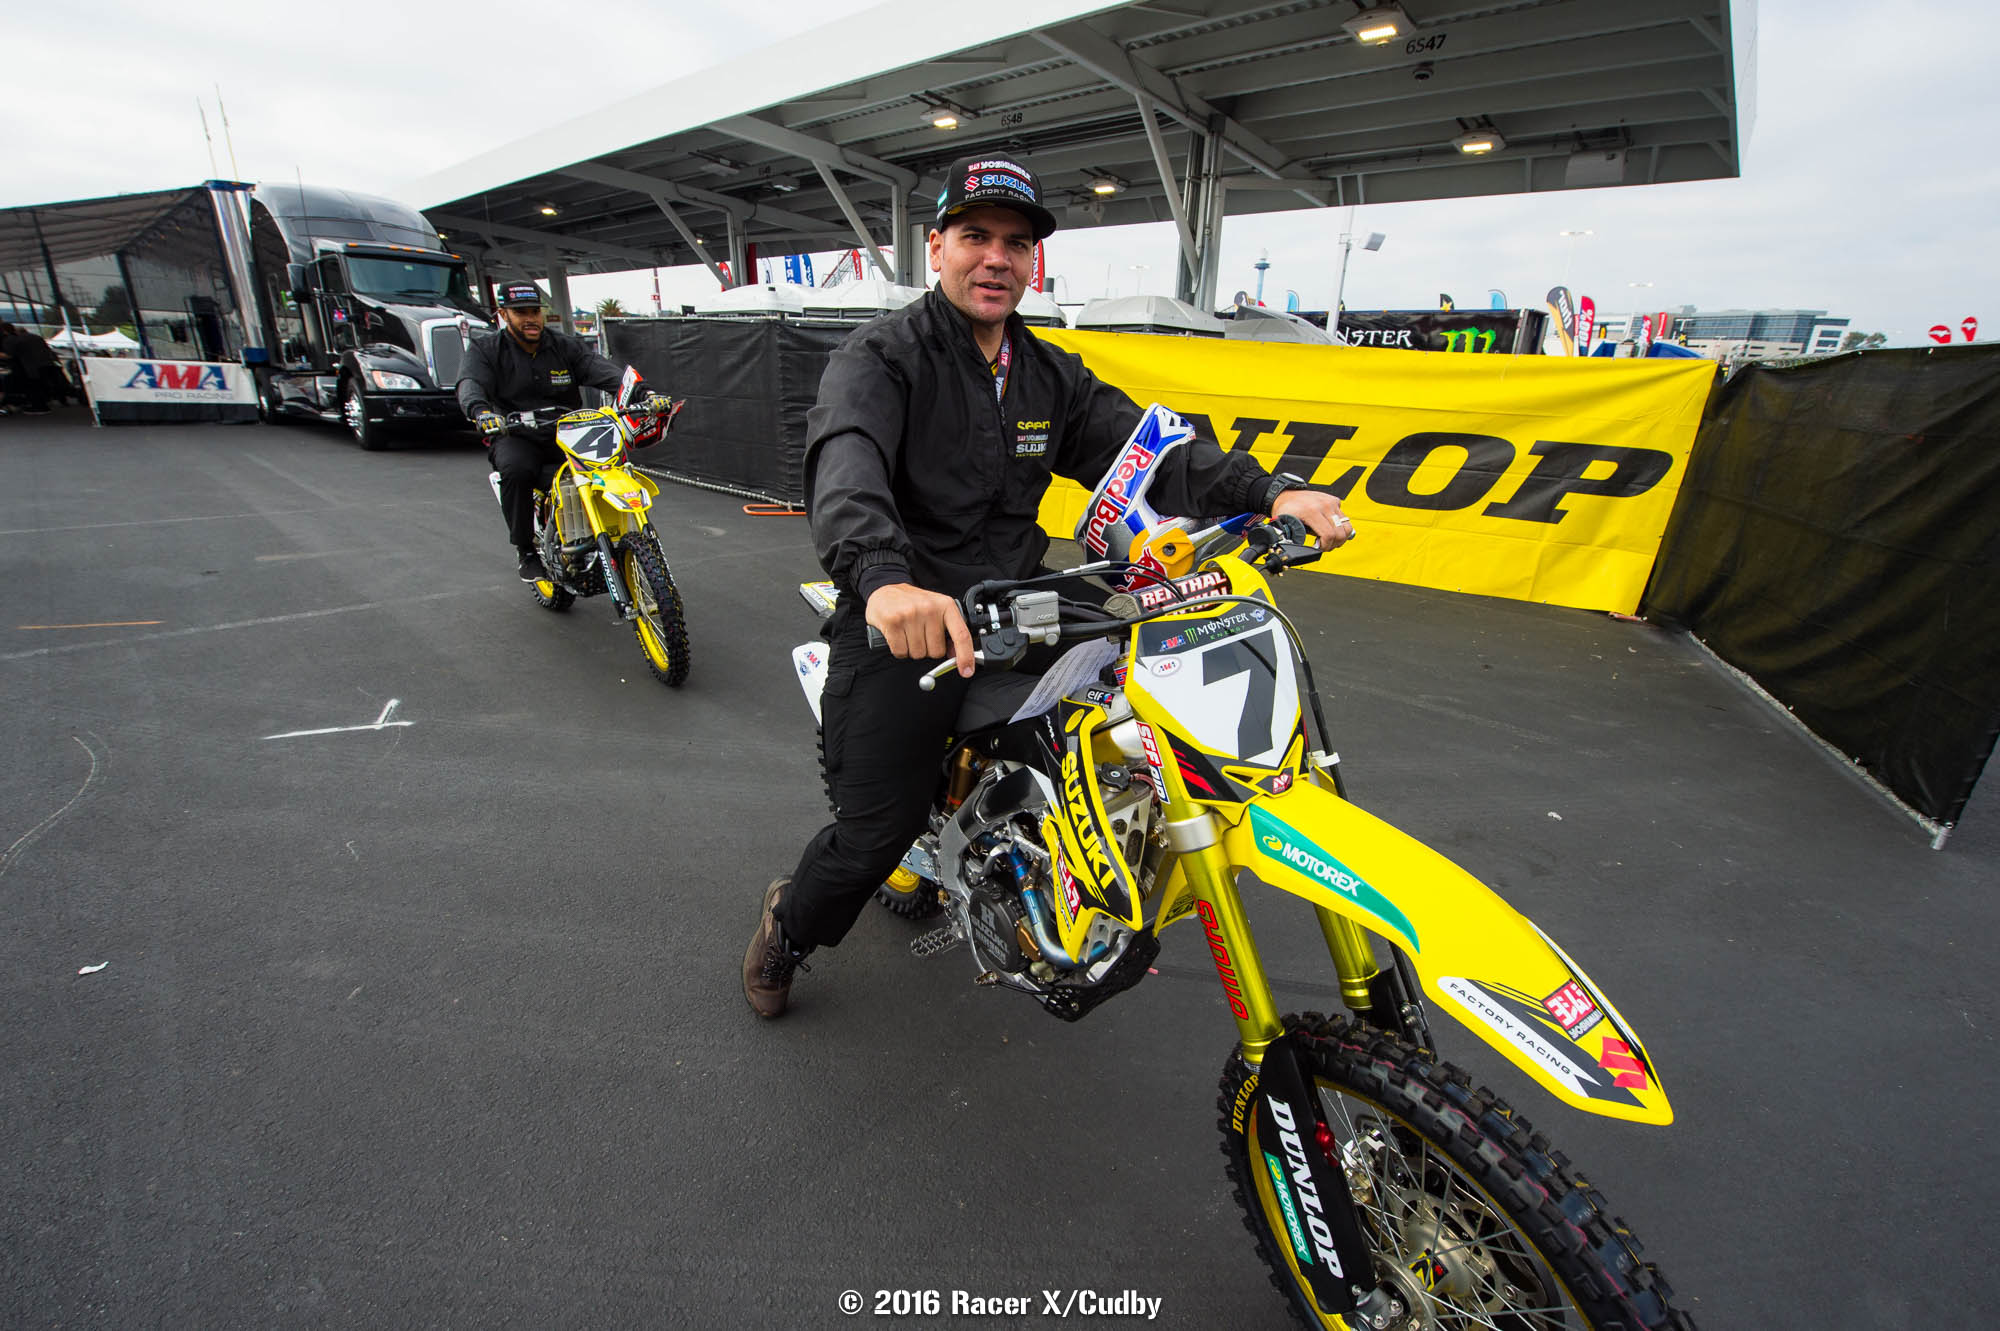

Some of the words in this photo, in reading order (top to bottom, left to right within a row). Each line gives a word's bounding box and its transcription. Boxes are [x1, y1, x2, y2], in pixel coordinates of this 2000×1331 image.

[965, 188, 1006, 200] FACTORY
[981, 175, 1035, 202] SUZUKI
[1336, 327, 1413, 348] NSTER
[118, 363, 232, 391] AMA
[154, 391, 182, 400] PRO
[186, 392, 233, 401] RACING
[571, 424, 617, 458] 4
[1175, 411, 1674, 524] NLOP
[1105, 442, 1157, 506] Red
[1085, 496, 1121, 559] Bull
[599, 551, 619, 601] DUNLOP
[1159, 634, 1186, 652] AMA
[1197, 612, 1250, 636] MONSTER
[1087, 690, 1104, 701] elf
[1201, 629, 1277, 760] 7
[1138, 723, 1161, 765] SFF
[1061, 751, 1117, 889] SUZUKI
[1282, 842, 1360, 897] MOTOREX
[1193, 896, 1248, 1020] SHOWA
[1449, 982, 1513, 1029] FACTORY
[1516, 1031, 1571, 1075] RACING
[1232, 1074, 1259, 1135] DUNLOP
[1266, 1093, 1344, 1279] DUNLOP
[1275, 1180, 1308, 1257] MOTOREX
